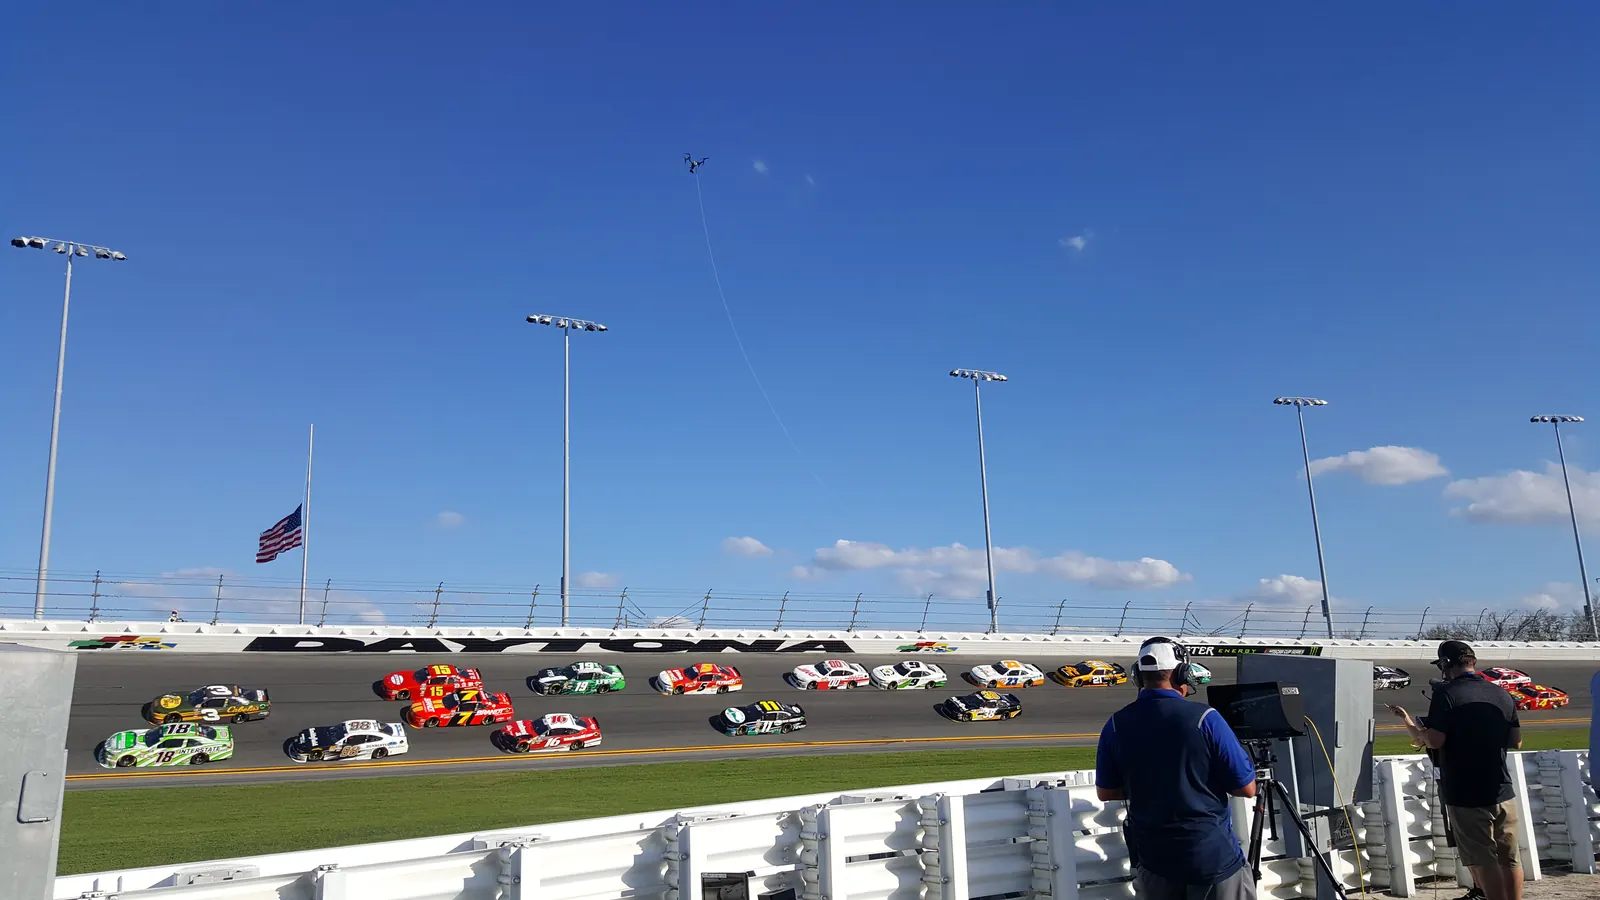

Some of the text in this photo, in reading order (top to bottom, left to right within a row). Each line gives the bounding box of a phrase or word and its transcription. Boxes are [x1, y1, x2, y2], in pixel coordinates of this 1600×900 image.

[241, 637, 855, 653] DAYTONA
[432, 664, 452, 675] 15
[827, 679, 840, 687] 00
[909, 678, 920, 687] 9
[1006, 677, 1018, 686] 23
[1092, 675, 1103, 684] 21
[206, 685, 233, 696] 3
[430, 686, 444, 697] 15
[574, 681, 589, 692] 19
[698, 681, 708, 692] 5
[459, 690, 479, 700] 7
[759, 701, 781, 711] 11
[1539, 699, 1548, 708] 4
[200, 708, 220, 721] 3
[456, 711, 474, 725] 7
[982, 707, 996, 718] 38
[551, 715, 568, 724] 16
[166, 723, 192, 736] 18
[760, 720, 775, 733] 11
[544, 736, 561, 748] 16
[178, 746, 220, 755] INTERSTATE
[155, 750, 176, 764] 18
